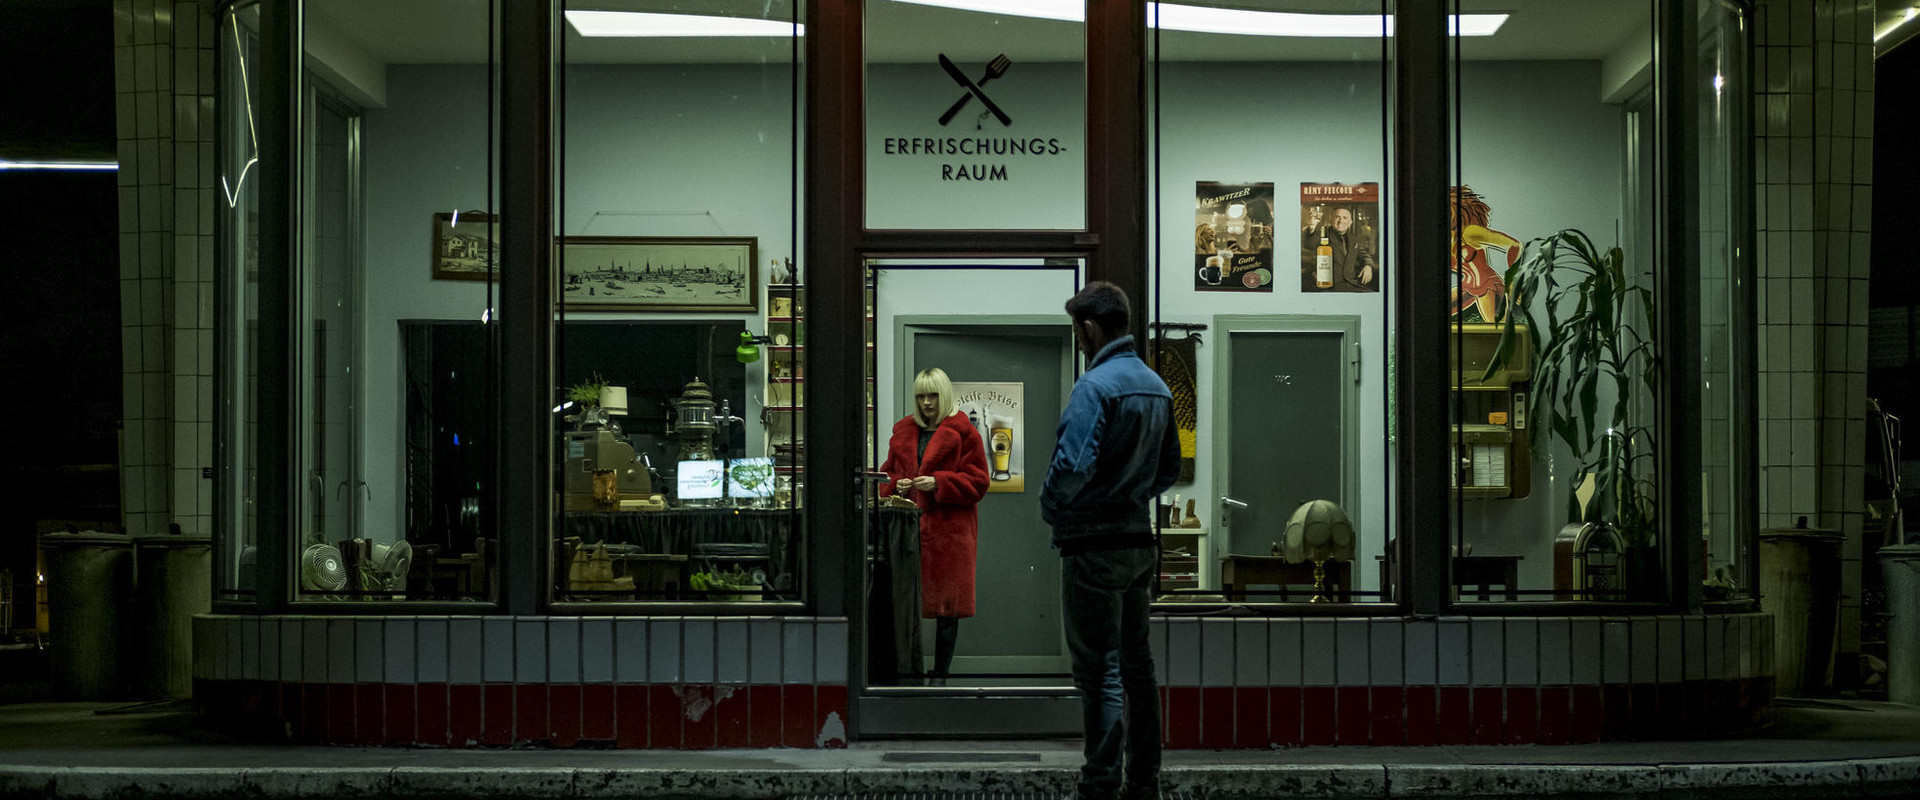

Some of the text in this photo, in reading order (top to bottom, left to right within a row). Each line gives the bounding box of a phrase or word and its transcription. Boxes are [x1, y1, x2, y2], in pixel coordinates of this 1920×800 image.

[884, 137, 1067, 156] ERFRISCHUNGS-
[941, 164, 1009, 181] RAUM
[1201, 187, 1251, 206] KRAWITZER
[1232, 261, 1262, 273] Freunde
[1238, 256, 1256, 265] Gute
[987, 391, 1018, 409] Brise
